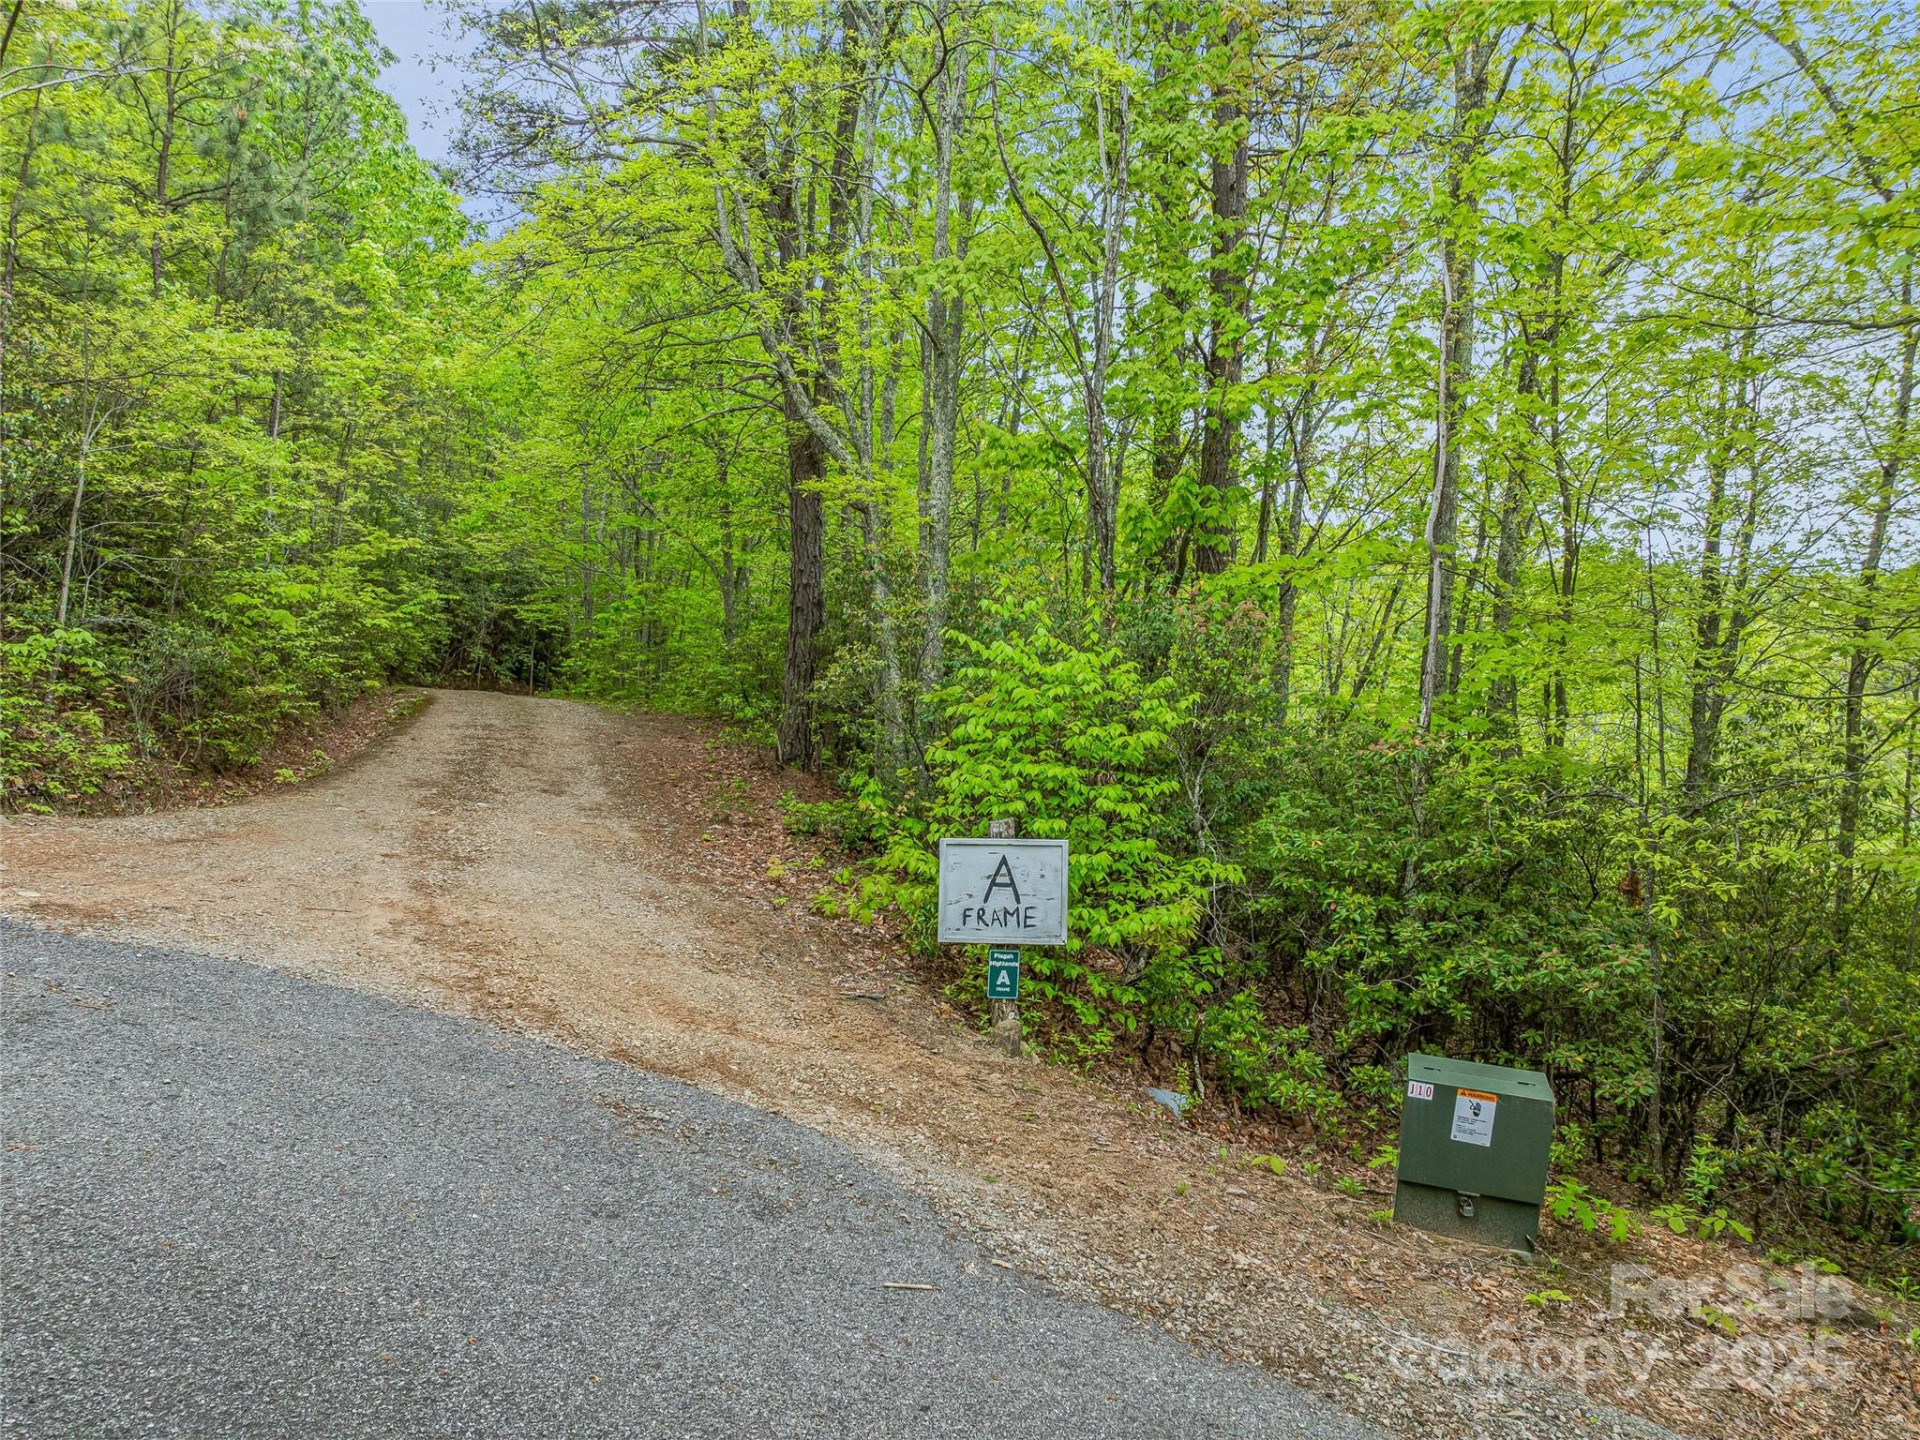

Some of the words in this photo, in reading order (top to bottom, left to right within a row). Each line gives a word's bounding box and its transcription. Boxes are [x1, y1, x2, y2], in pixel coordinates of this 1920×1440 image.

[983, 854, 1021, 905] A
[962, 906, 1037, 929] FRAME
[993, 952, 1014, 960] Pisgah
[996, 970, 1010, 985] A
[1410, 1084, 1432, 1097] J10
[1467, 1092, 1495, 1102] WARNING
